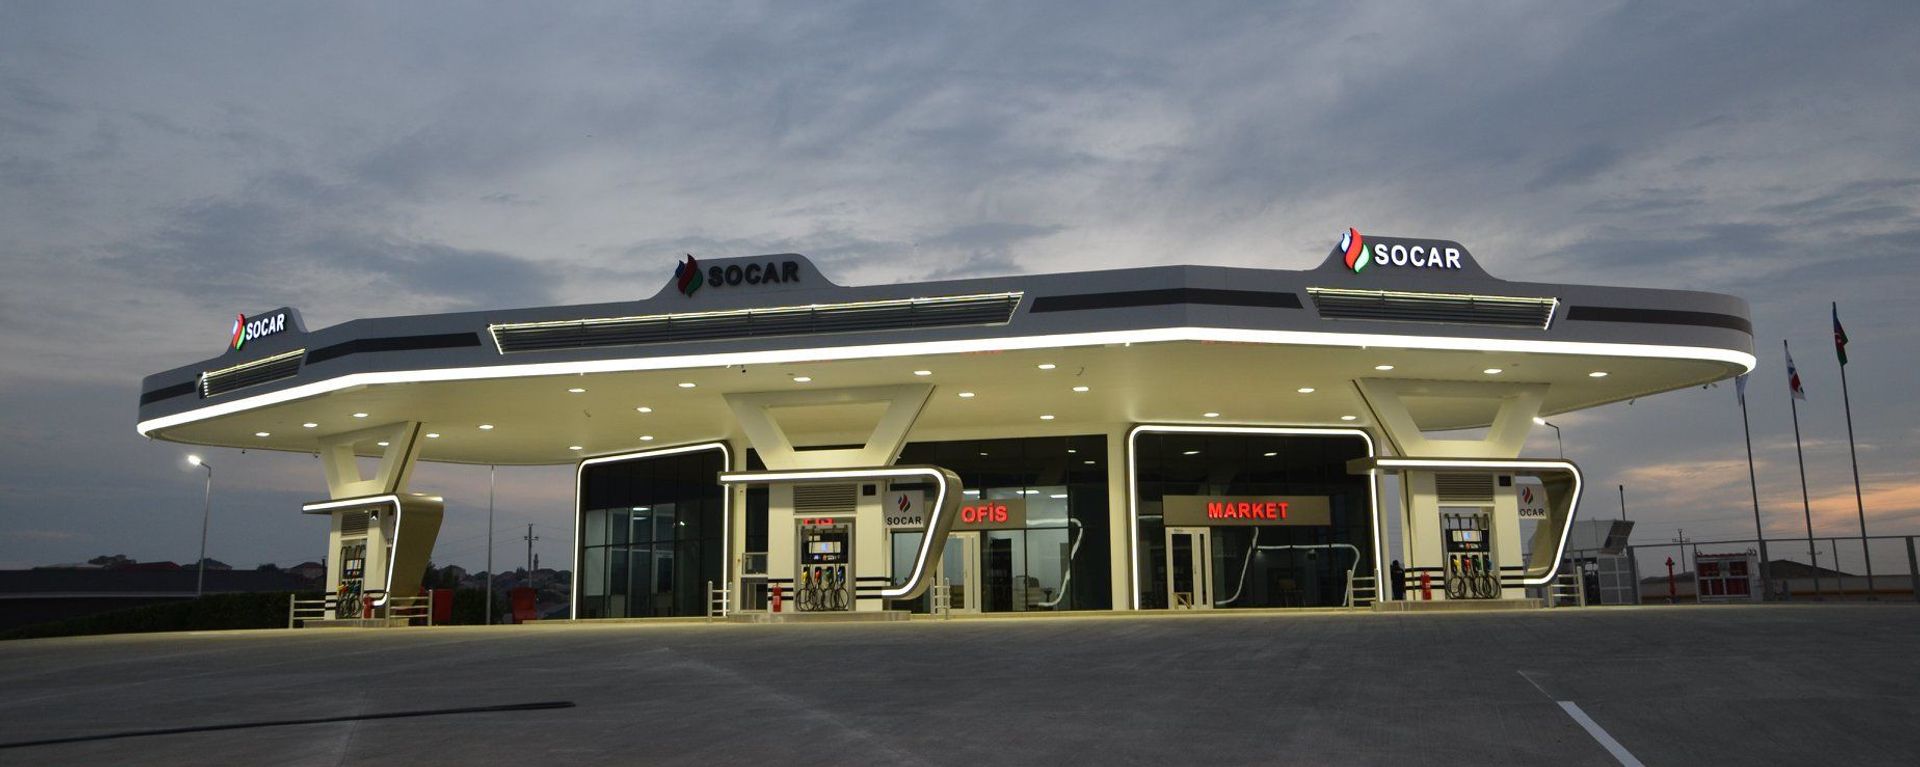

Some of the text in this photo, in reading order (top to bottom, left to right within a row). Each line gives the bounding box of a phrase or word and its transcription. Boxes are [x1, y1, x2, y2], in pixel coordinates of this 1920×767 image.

[1374, 243, 1461, 268] SOCAR
[708, 261, 799, 287] SOCAR
[246, 313, 285, 340] SOCAR
[886, 516, 921, 525] SOCAR
[961, 502, 1008, 523] OFİS
[1208, 502, 1288, 519] MARKET
[1520, 508, 1545, 516] OCAR
